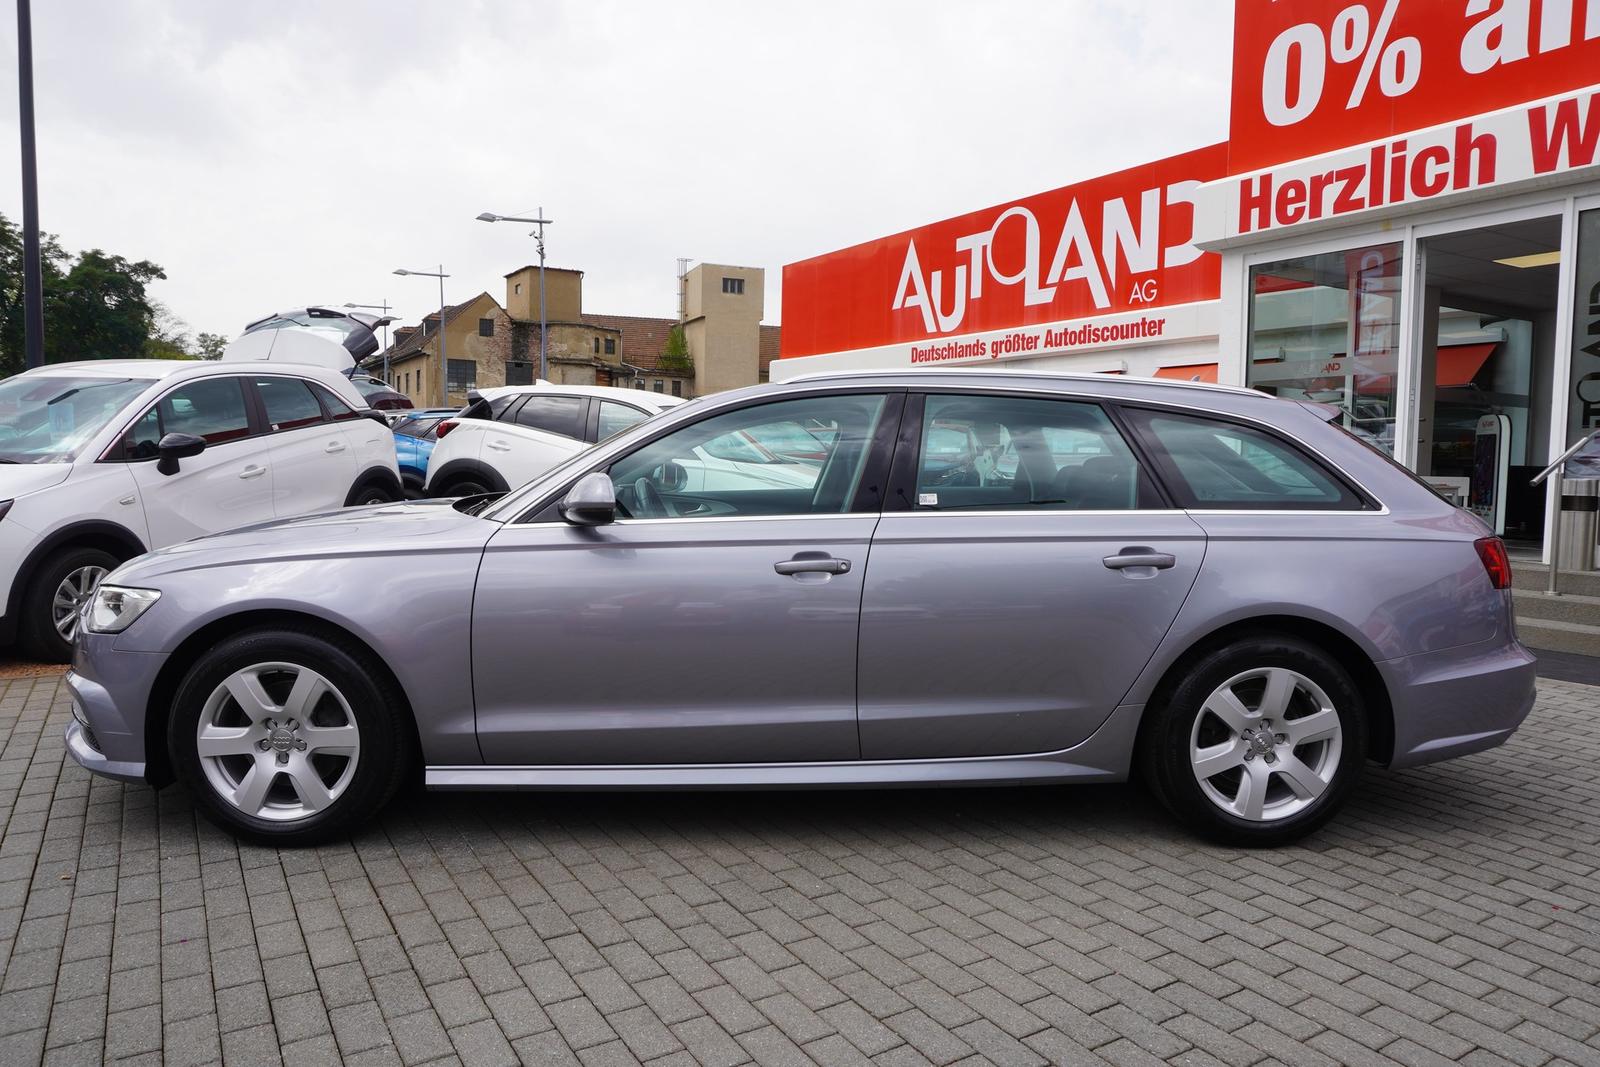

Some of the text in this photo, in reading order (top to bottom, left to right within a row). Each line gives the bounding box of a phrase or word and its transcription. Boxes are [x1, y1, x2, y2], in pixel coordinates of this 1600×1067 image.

[1262, 0, 1421, 126] 0%
[1238, 123, 1497, 233] Herzlich
[892, 180, 1206, 333] AUTOLAND
[1129, 279, 1157, 304] AG
[911, 317, 1165, 363] Deutschlands größter Autodiscounter
